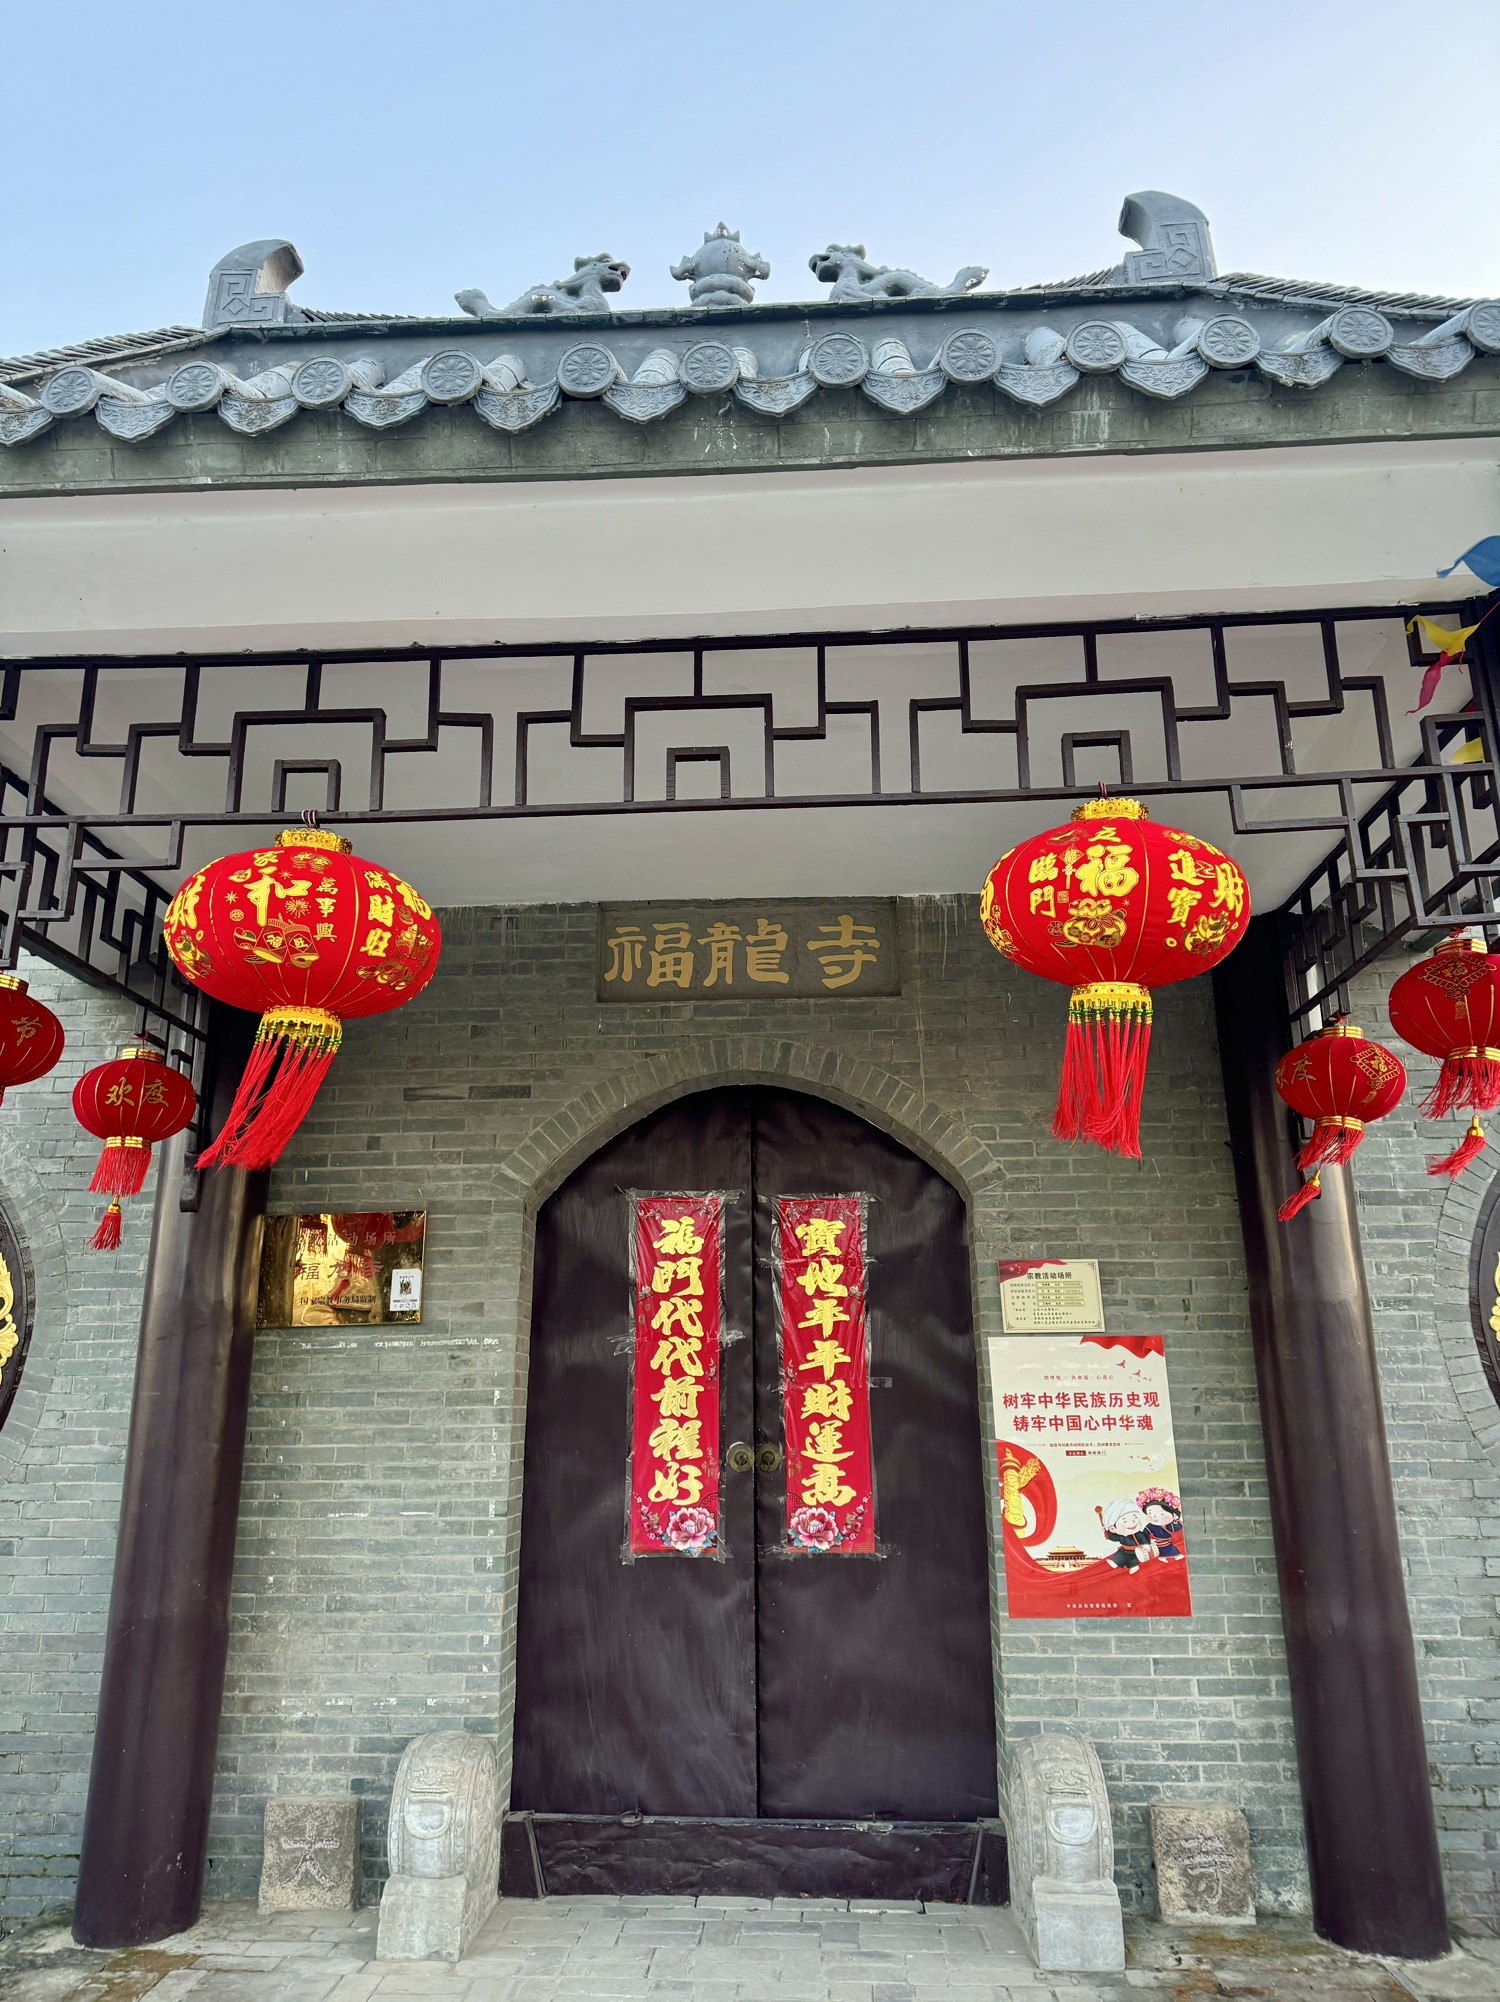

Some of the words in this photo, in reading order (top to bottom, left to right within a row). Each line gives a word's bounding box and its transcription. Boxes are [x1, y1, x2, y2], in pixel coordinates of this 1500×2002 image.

[603, 914, 881, 990] 福龍寺
[104, 1076, 170, 1108] 欢度
[1027, 1271, 1072, 1280] 宗教活动场所
[1002, 1391, 1160, 1410] 树牢中华民族历史观
[1013, 1413, 1154, 1433] 铸牢中国心中华魂
